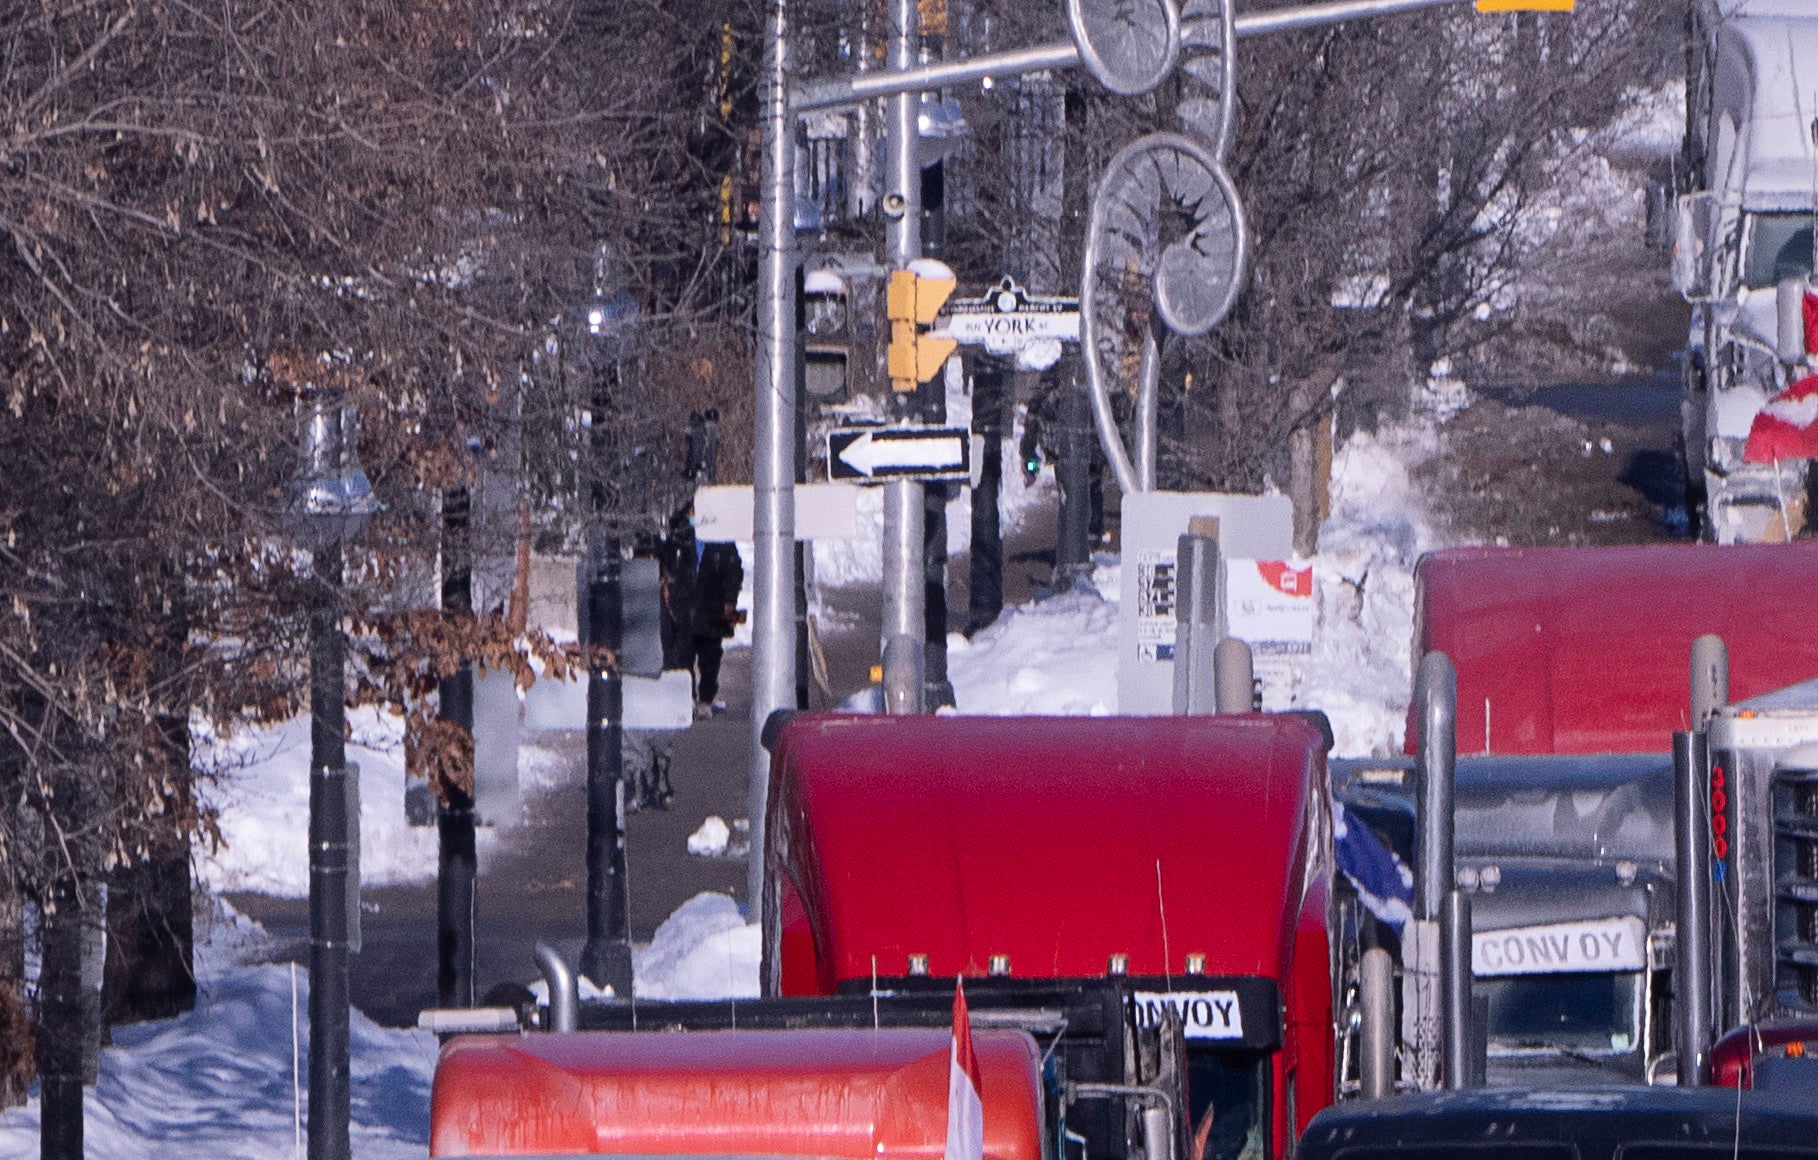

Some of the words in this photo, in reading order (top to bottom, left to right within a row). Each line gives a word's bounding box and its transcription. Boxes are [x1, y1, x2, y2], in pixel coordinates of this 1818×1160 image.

[985, 318, 1034, 335] YORK
[1480, 931, 1622, 969] CONVOY
[1134, 998, 1233, 1028] ONVOY
